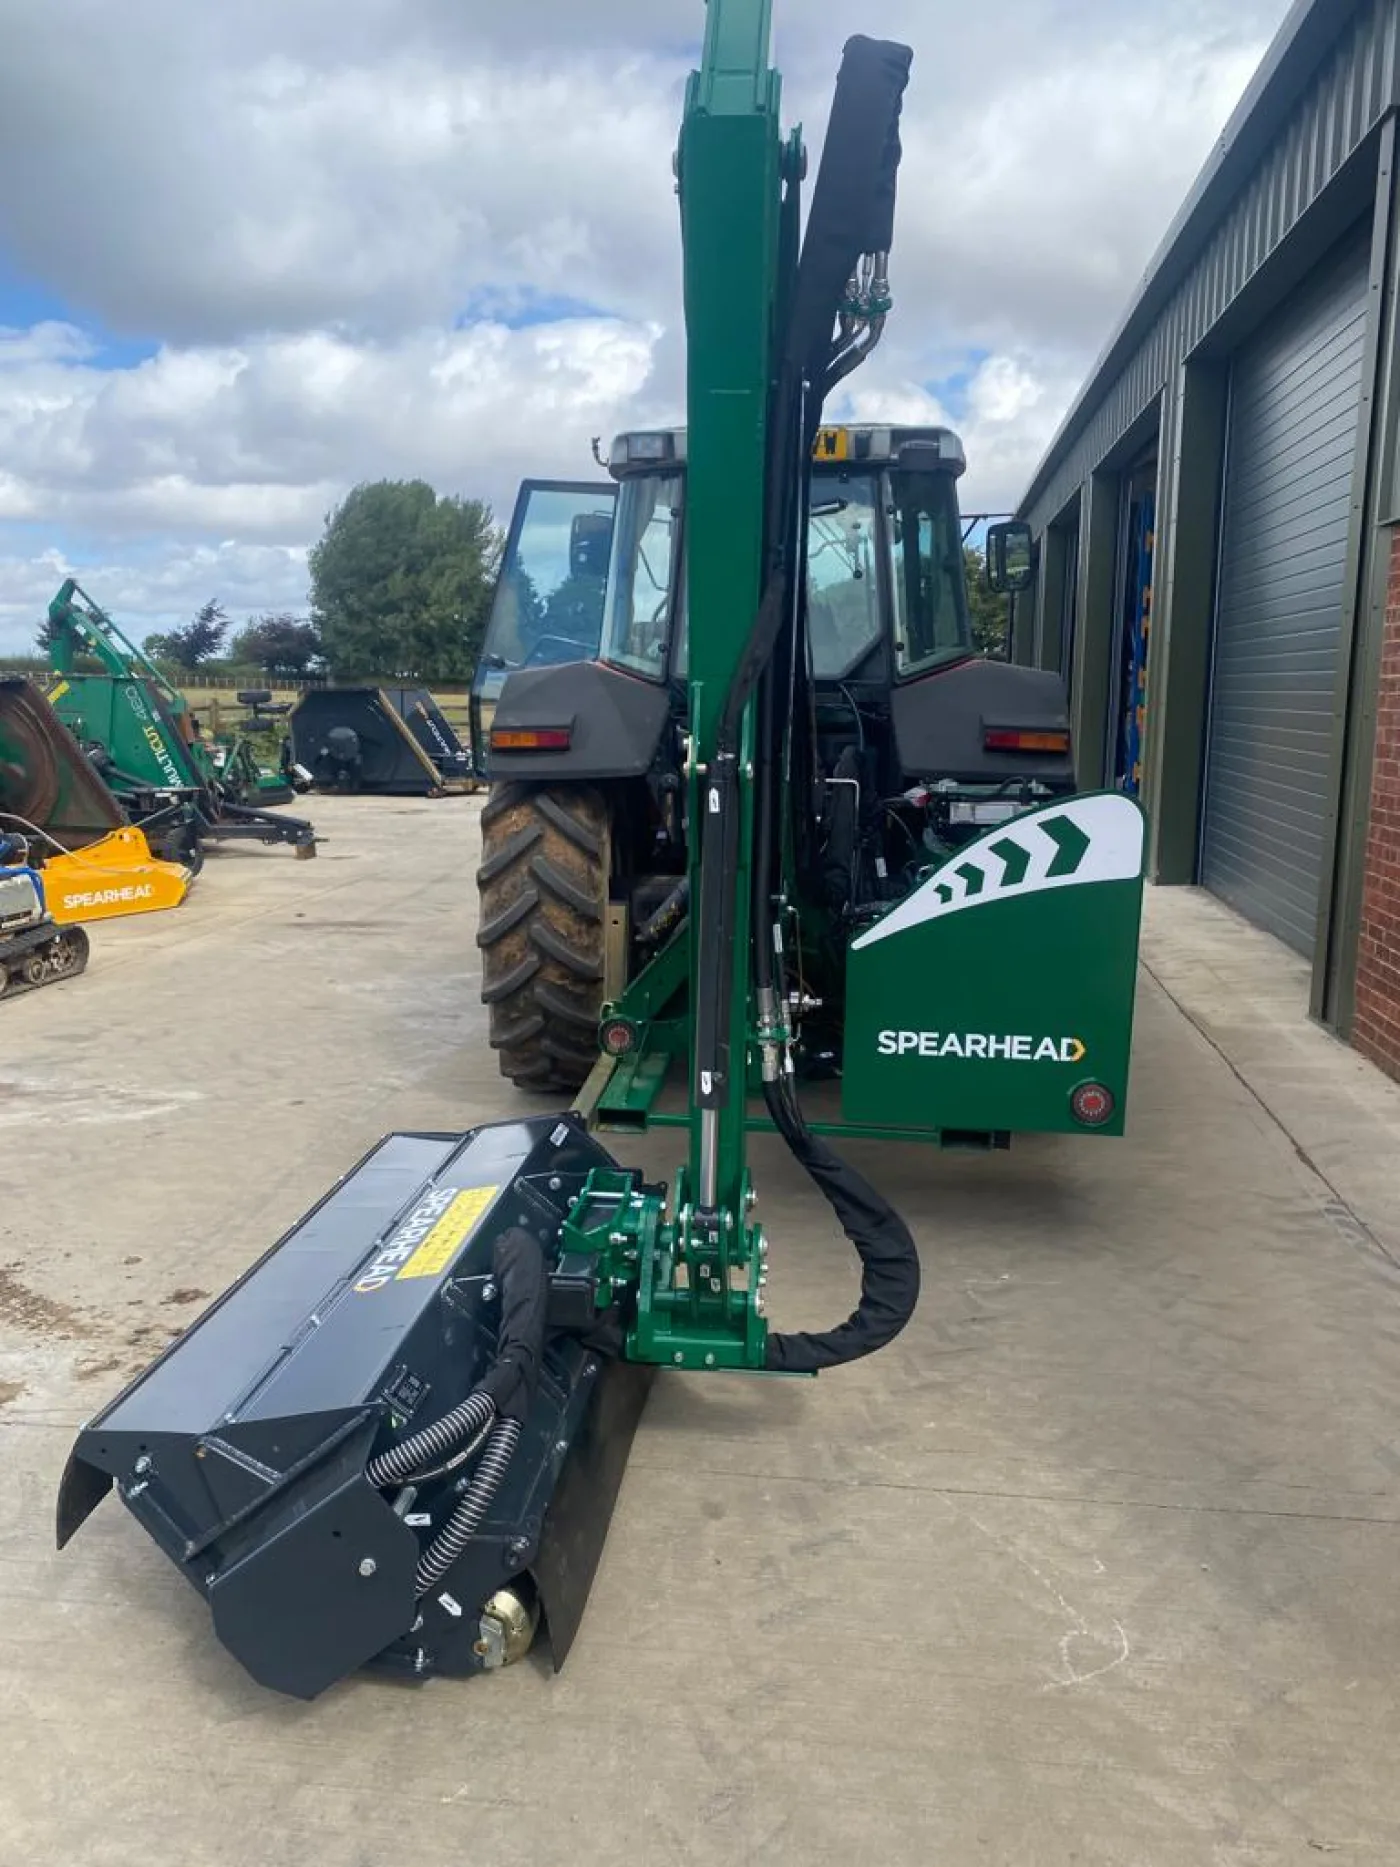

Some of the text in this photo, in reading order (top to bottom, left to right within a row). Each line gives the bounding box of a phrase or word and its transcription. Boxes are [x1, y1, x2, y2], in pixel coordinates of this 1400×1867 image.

[142, 724, 185, 789] MULTICUT
[63, 883, 155, 909] SPEARHEAD
[877, 1029, 1087, 1063] SPEARHEAD
[352, 1187, 459, 1293] SPEARHEAD
